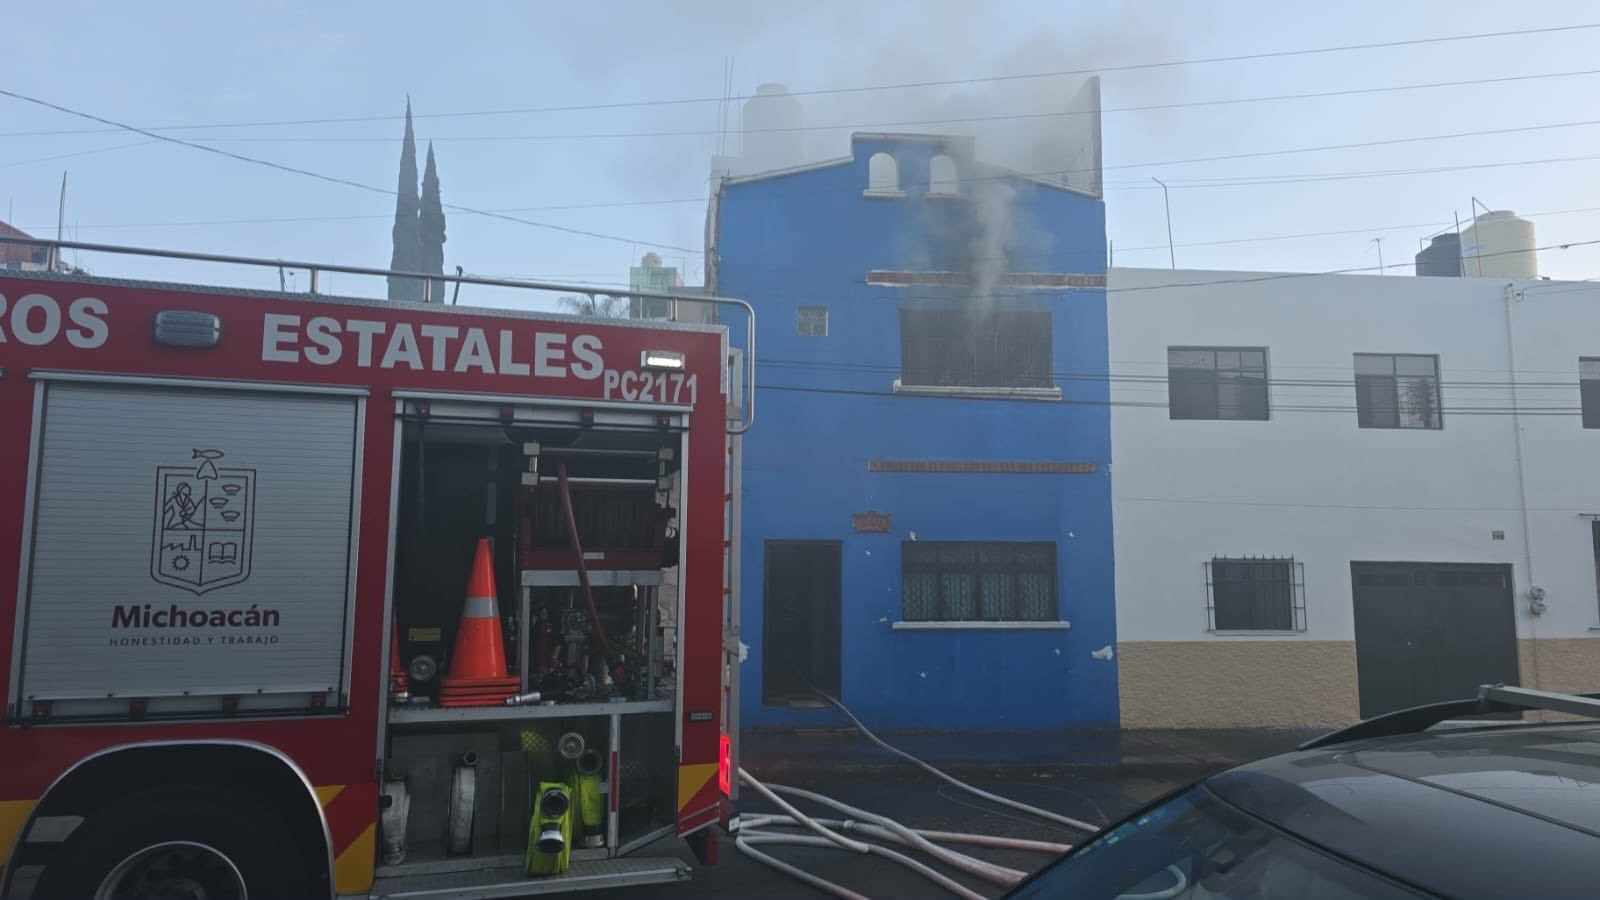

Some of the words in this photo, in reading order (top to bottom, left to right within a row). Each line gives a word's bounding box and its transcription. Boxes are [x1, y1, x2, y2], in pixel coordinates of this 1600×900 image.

[0, 293, 109, 349] OS
[262, 312, 605, 380] ESTATALES
[604, 369, 698, 405] PC2171
[112, 604, 280, 628] Michoacán
[109, 635, 201, 647] HONESTIDAD
[207, 637, 215, 645] Y
[221, 635, 280, 646] TRABAJO
